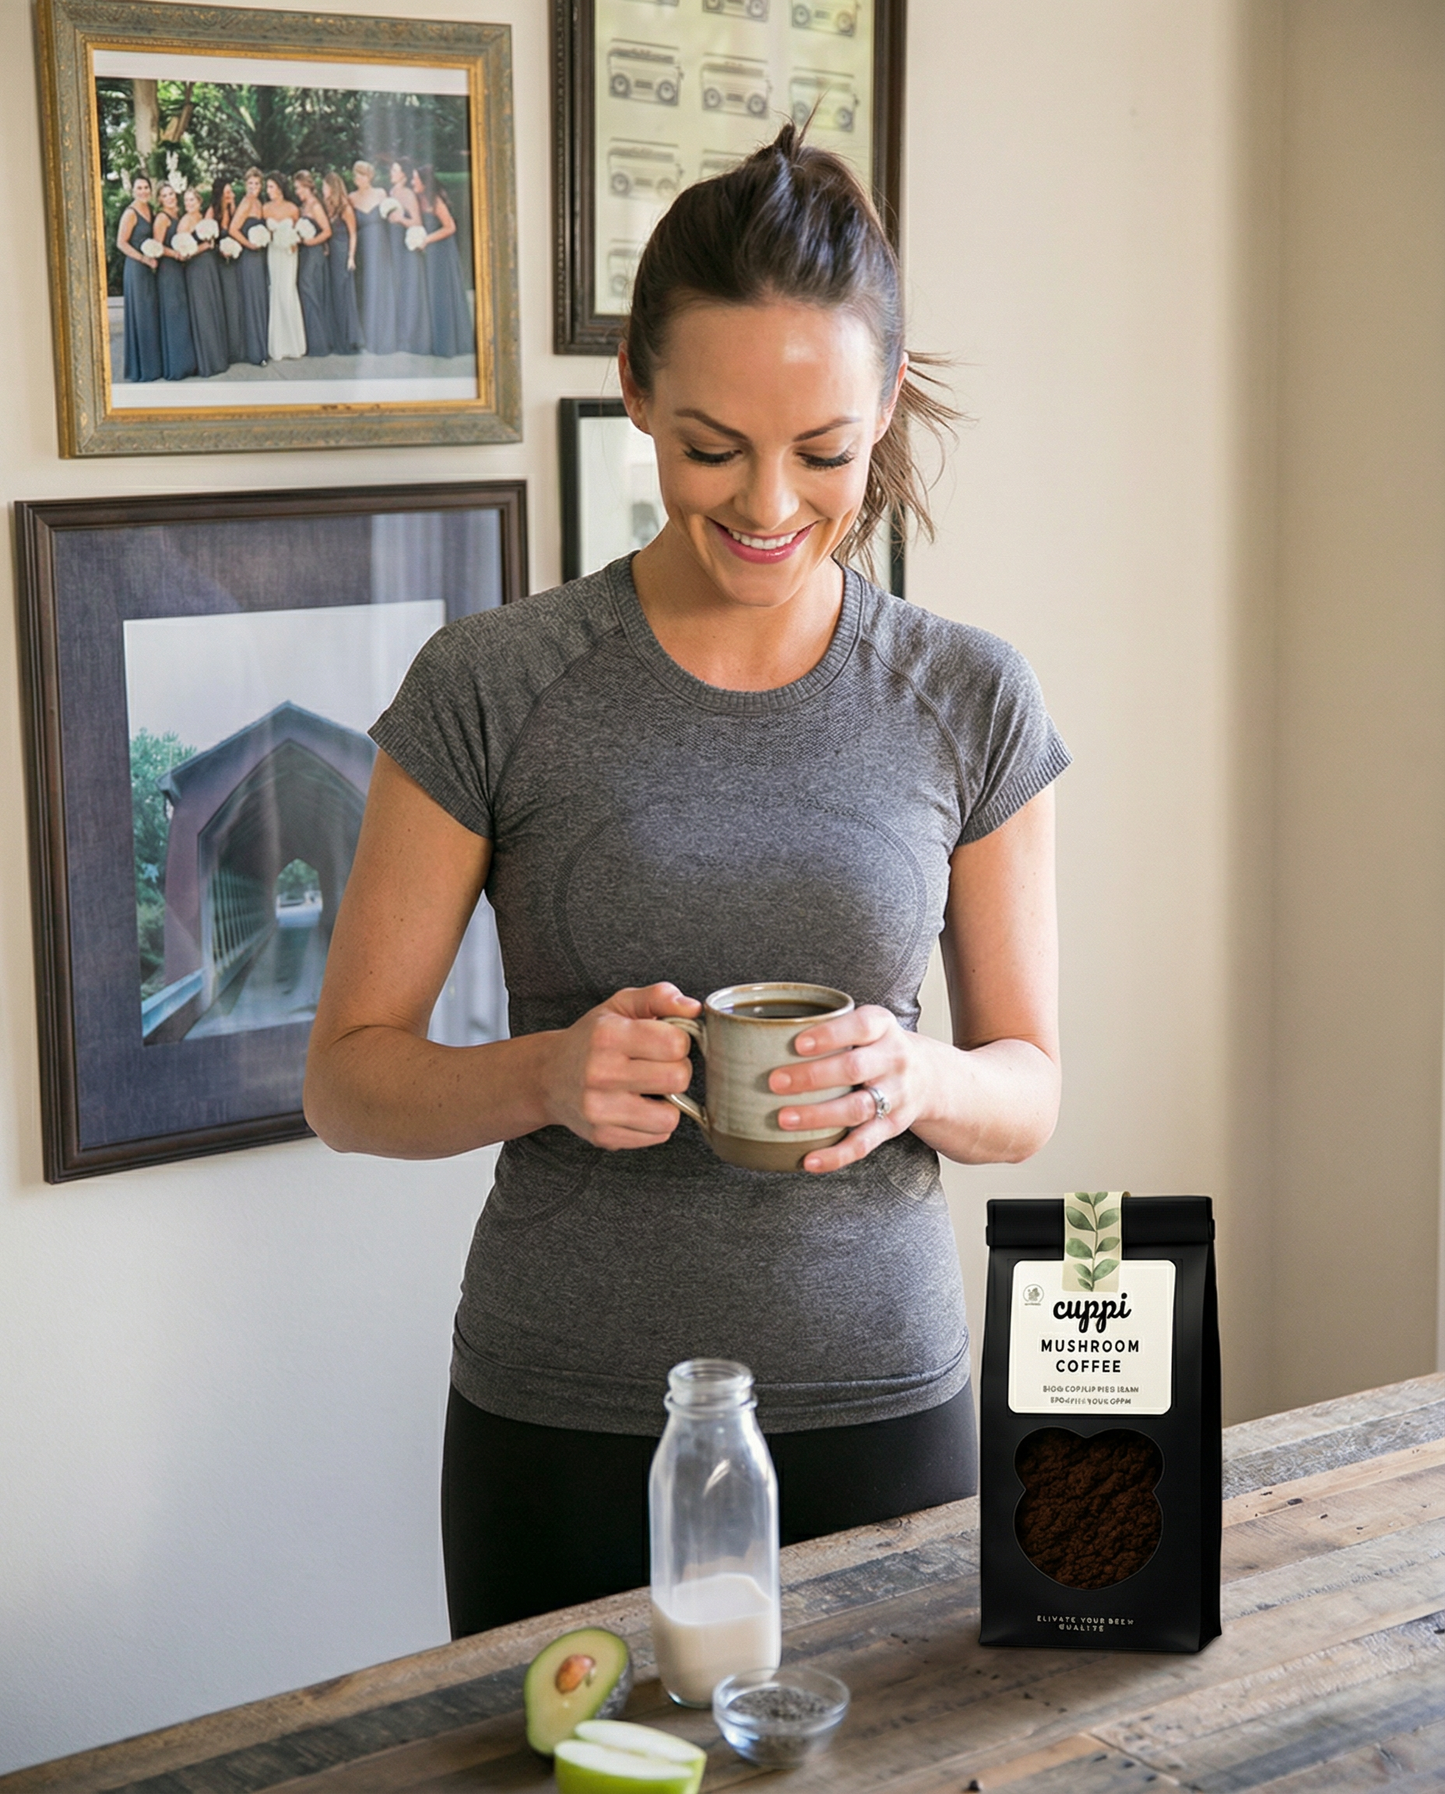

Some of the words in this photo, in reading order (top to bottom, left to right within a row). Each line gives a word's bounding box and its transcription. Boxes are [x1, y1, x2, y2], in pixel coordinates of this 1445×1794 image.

[1053, 1292, 1132, 1333] cuppi
[1041, 1339, 1139, 1353] MUSHROOM
[1055, 1359, 1121, 1373] COFFEE
